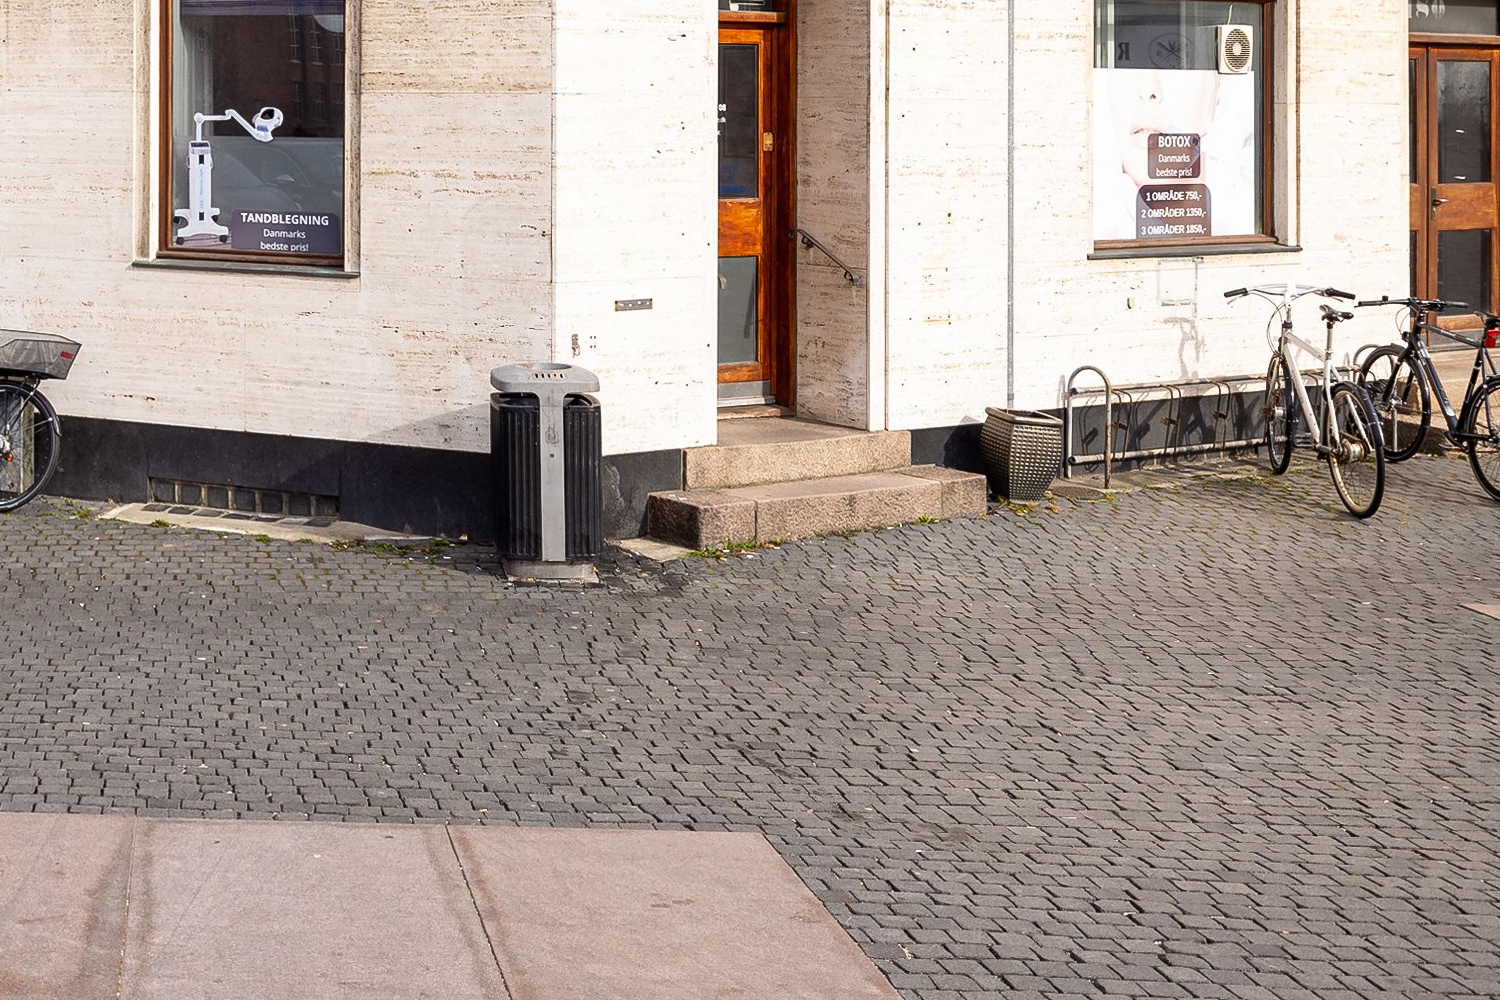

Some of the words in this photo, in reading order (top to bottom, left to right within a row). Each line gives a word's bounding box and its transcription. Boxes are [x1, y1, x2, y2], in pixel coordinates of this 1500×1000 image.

[1158, 136, 1191, 147] BOTOX
[1158, 154, 1190, 162] Danmarks
[1156, 168, 1178, 177] bedste
[1178, 168, 1192, 178] pris!
[1146, 192, 1151, 201] 1
[1152, 190, 1185, 200] OMRÅDE
[1186, 191, 1202, 201] 750,-
[1142, 210, 1146, 218] 2
[1148, 207, 1185, 218] OMRÅDER
[1186, 208, 1206, 218] 1350,-
[240, 213, 329, 226] TANDBLEGNING
[263, 229, 306, 239] Danmarks
[1142, 226, 1146, 235] 3
[1148, 224, 1185, 234] OMRÅDER
[1186, 224, 1206, 234] 1850,-
[260, 241, 288, 251] bedste
[290, 244, 308, 252] pris!
